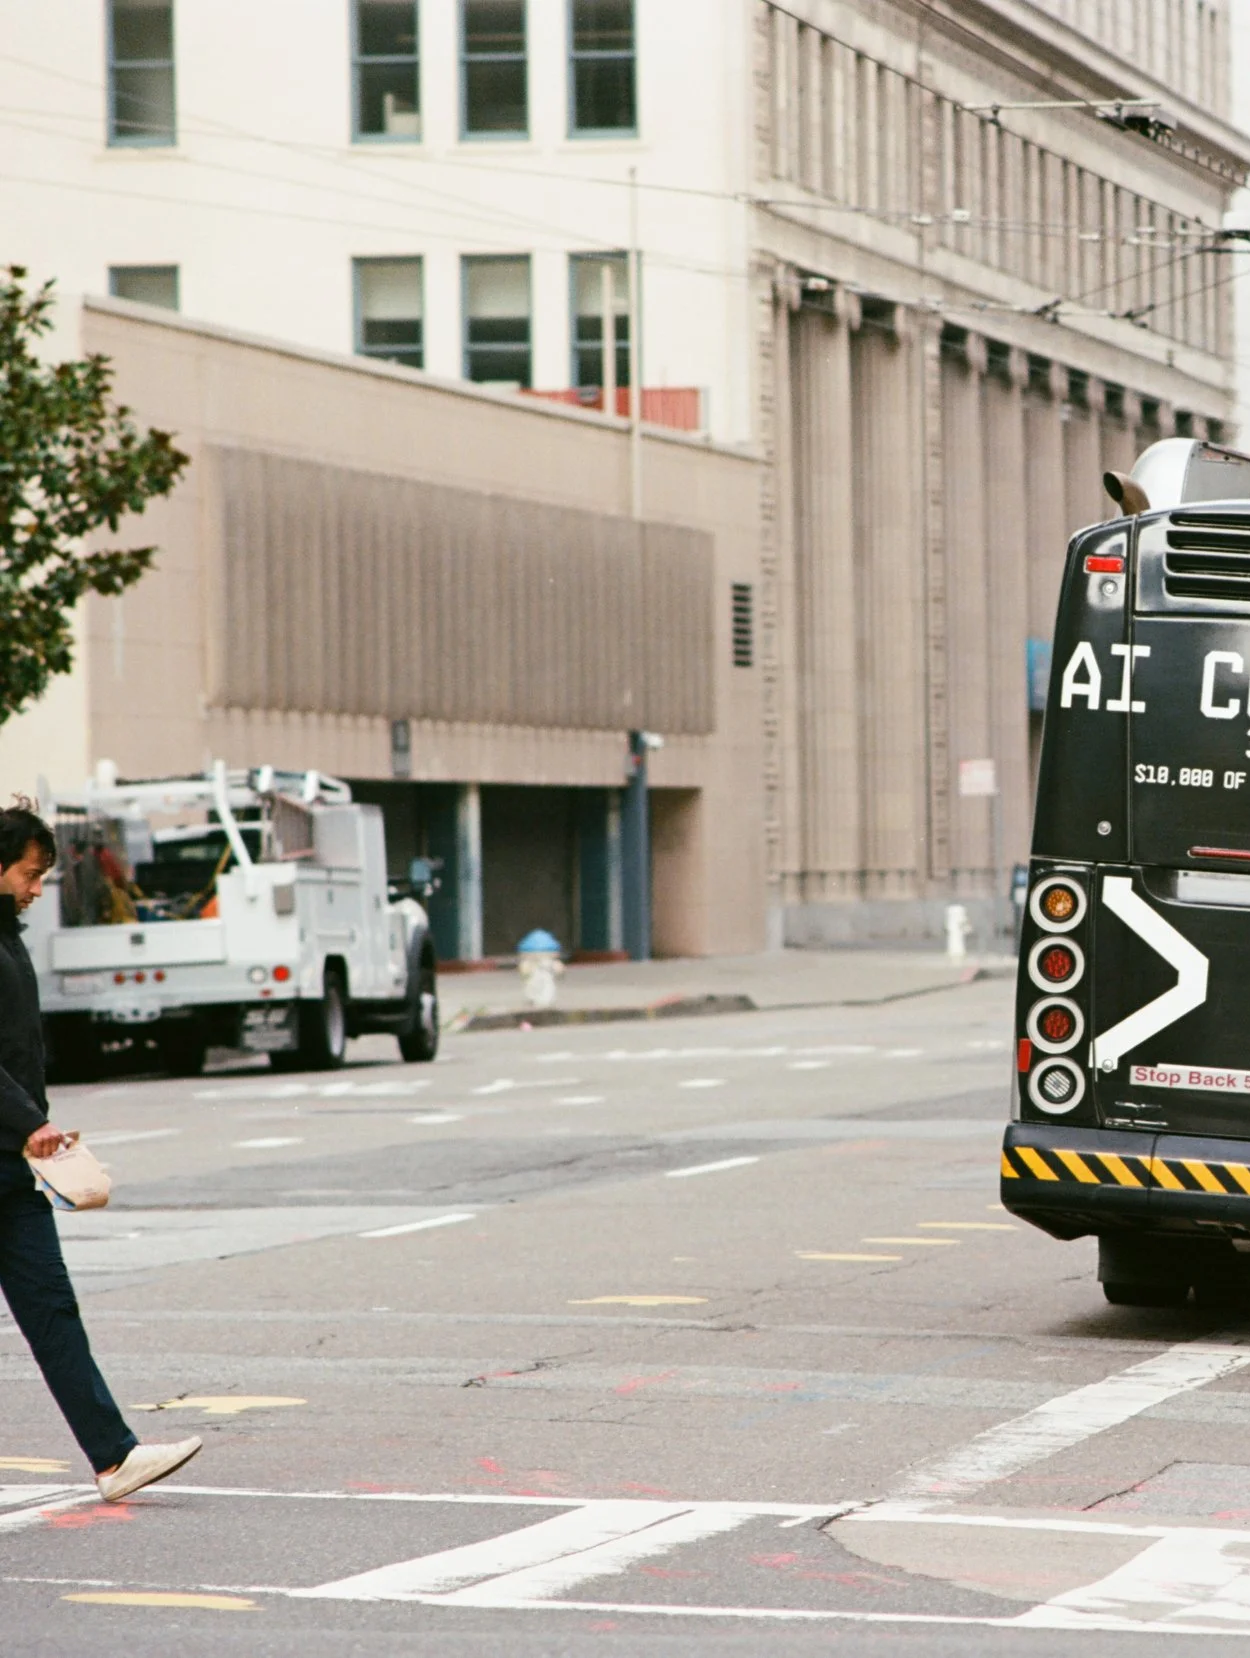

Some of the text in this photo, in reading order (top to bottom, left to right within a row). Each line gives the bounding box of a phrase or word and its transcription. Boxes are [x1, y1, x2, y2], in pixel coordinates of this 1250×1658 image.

[1060, 641, 1151, 713] AI
[1134, 763, 1214, 788] $10,000
[1223, 771, 1247, 790] OF
[1135, 1066, 1181, 1087] Stop
[1188, 1071, 1237, 1088] Back
